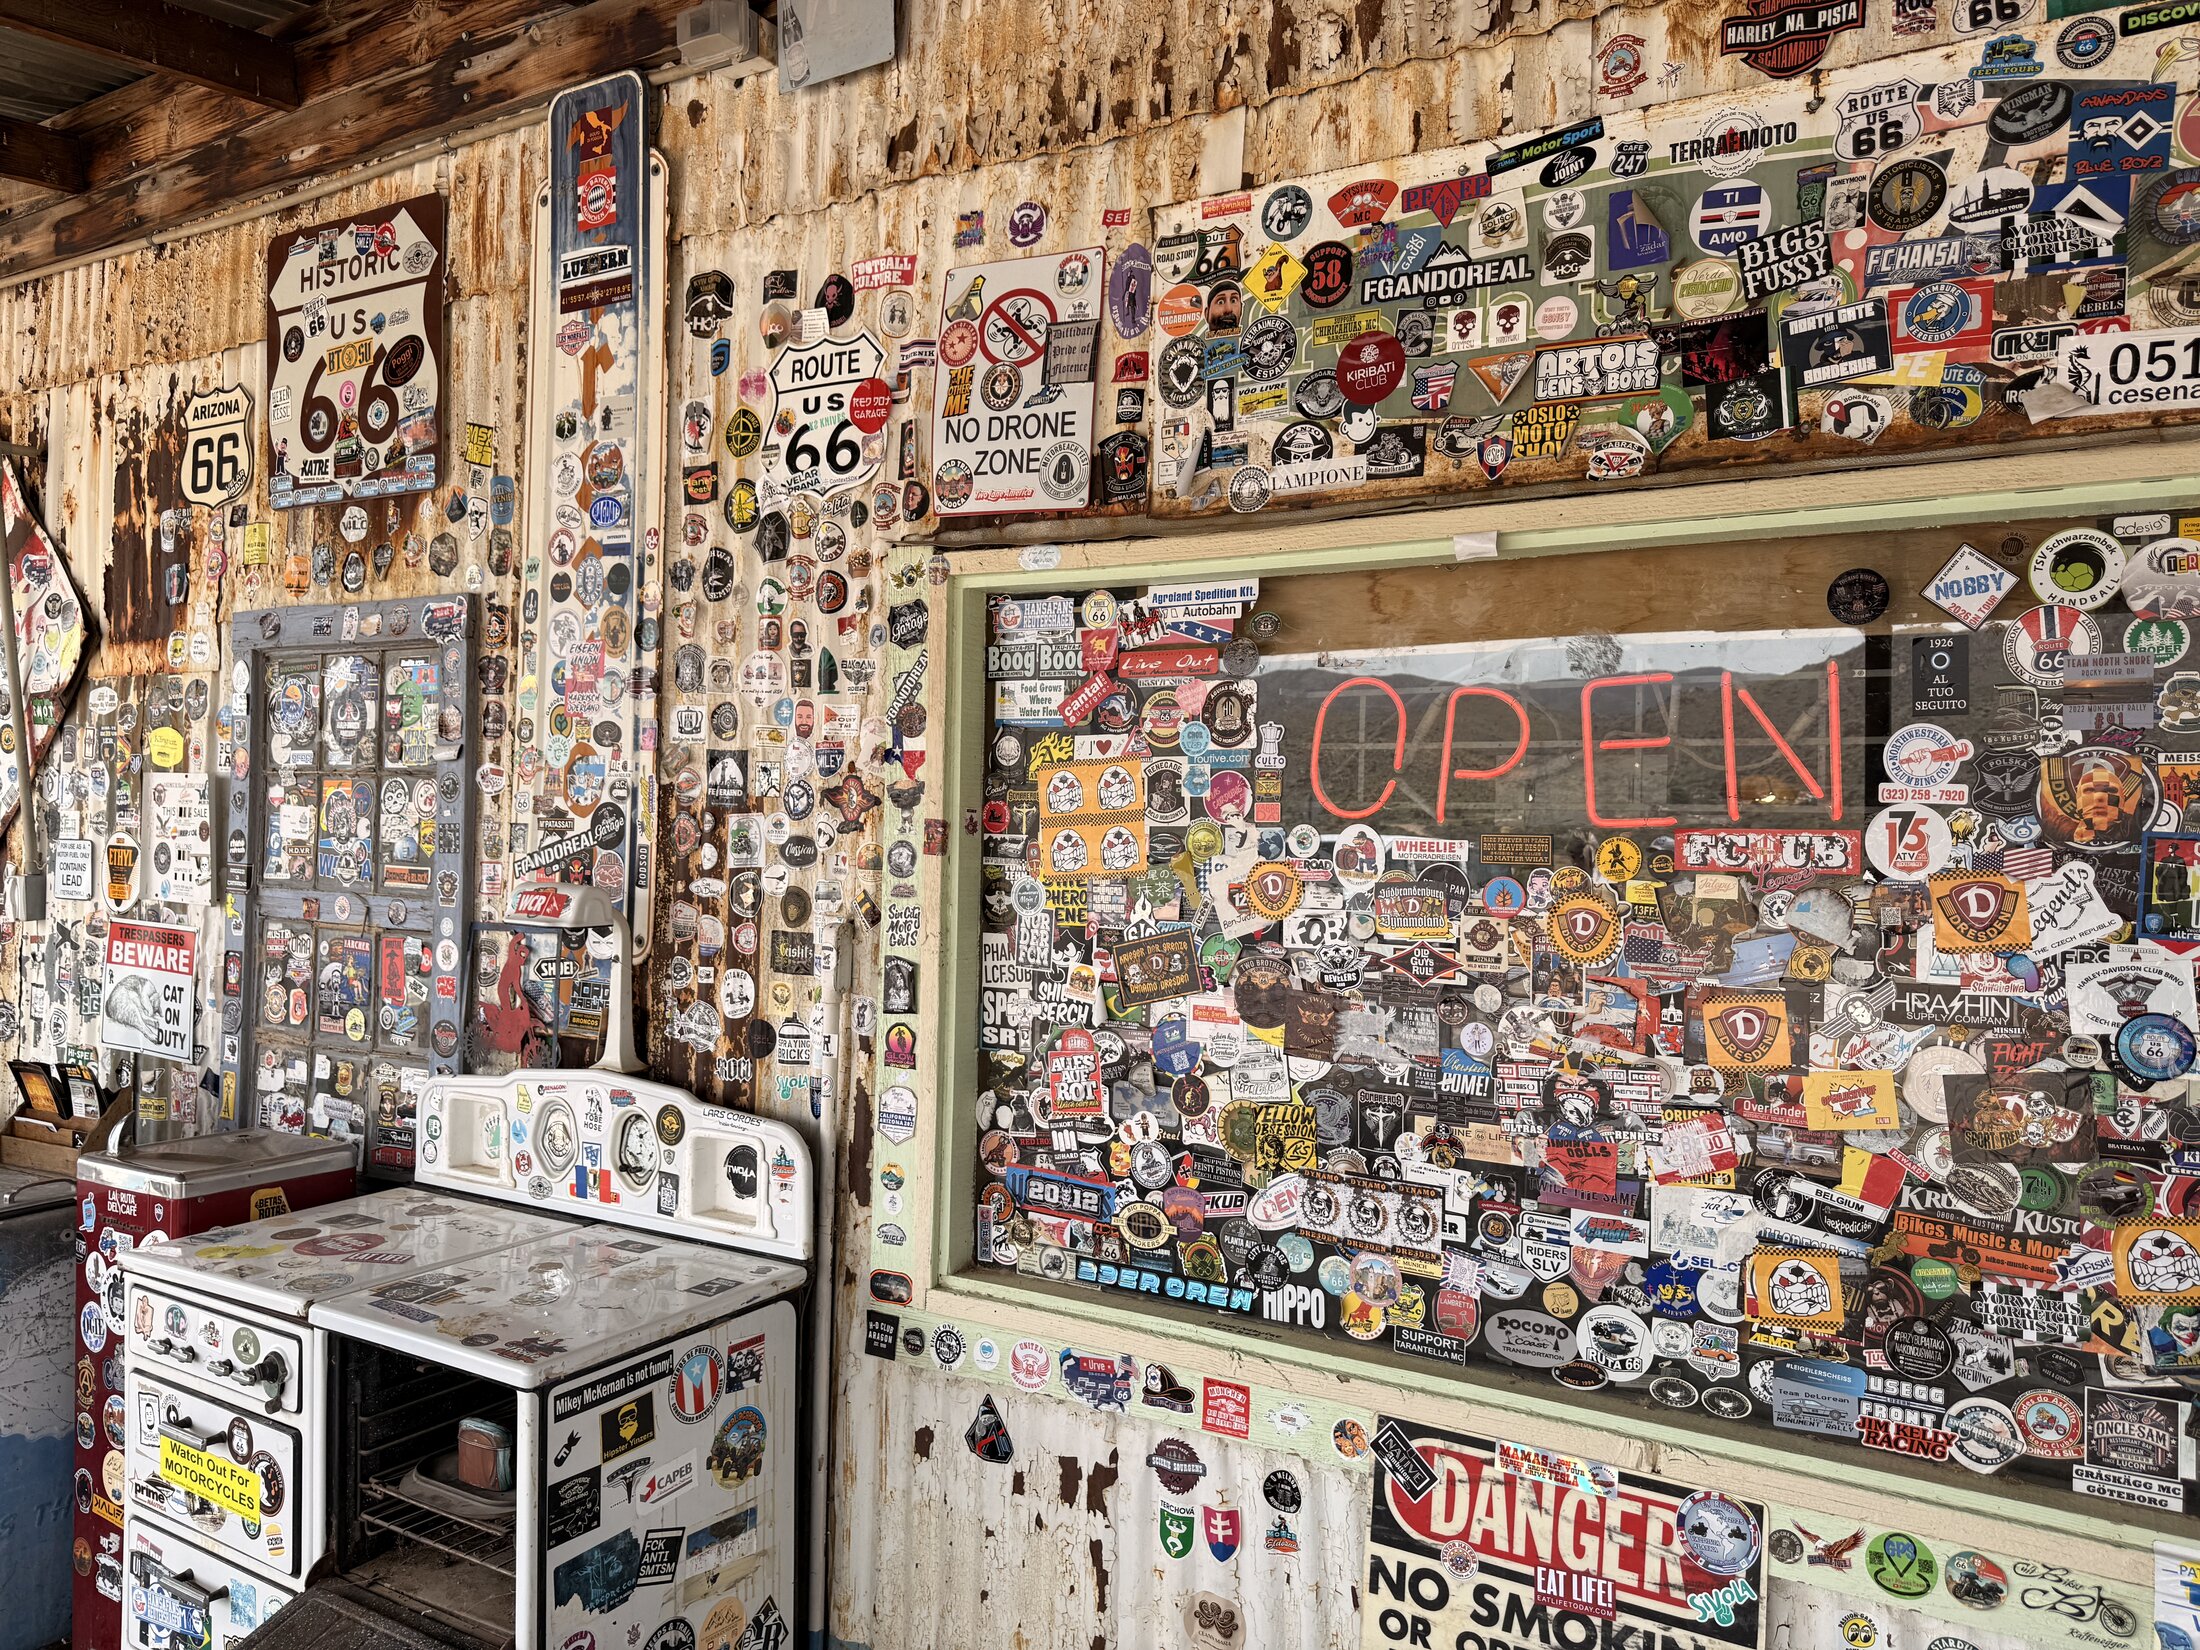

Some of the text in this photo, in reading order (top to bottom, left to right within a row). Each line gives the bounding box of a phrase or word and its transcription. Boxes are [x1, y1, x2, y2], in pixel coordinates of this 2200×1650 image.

[2077, 41, 2094, 52] 66
[1972, 63, 2041, 77] JEEP TOURS
[1848, 85, 1908, 113] ROUTE
[2001, 83, 2053, 112] WINGMAN
[1522, 122, 1602, 159] MotorSport
[1622, 143, 1644, 152] CAFE
[1852, 119, 1905, 158] 66
[1615, 153, 1642, 175] 247
[1830, 174, 1867, 187] HONEYMOON
[1723, 192, 1740, 205] TI
[1354, 211, 1371, 223] MC
[355, 235, 373, 249] SMILEY
[1709, 229, 1748, 245] AMO
[1310, 248, 1347, 262] SUPPORT
[301, 245, 400, 293] HISTORIC
[853, 256, 912, 278] FOOTBALL
[1311, 260, 1341, 291] 58
[1744, 248, 1828, 300] FUSSY
[1363, 256, 1534, 303] FGANDOREAL
[1917, 282, 1962, 298] HAMBURG
[2078, 299, 2124, 314] REBELS
[331, 309, 366, 339] US
[1788, 301, 1875, 335] NORTH GATE
[1908, 324, 1957, 343] BERGEDORF
[791, 349, 861, 383] ROUTE
[1537, 341, 1659, 378] ARTOIS
[1354, 375, 1388, 391] CLUB
[1964, 372, 1981, 384] 66
[300, 343, 399, 453] 66
[802, 393, 845, 414] US
[192, 399, 240, 421] ARIZONA
[1528, 404, 1566, 425] OSLO
[945, 410, 1077, 444] NO DRONE
[785, 418, 861, 476] 66
[1601, 441, 1639, 451] CABRAS
[191, 433, 239, 494] 66
[974, 447, 1041, 476] ZONE
[787, 478, 821, 495] PRANA
[1116, 492, 1146, 504] MALAYSIA
[1151, 585, 1256, 604] Agroland Spedition Kft.
[1934, 571, 2006, 601] NOBBY
[1091, 610, 1107, 622] 66
[1183, 603, 1237, 619] Autobahn
[1929, 637, 1954, 648] 1926
[988, 645, 1036, 670] Boog
[1020, 683, 1062, 693] Food Grows
[1927, 687, 1954, 697] TUO
[1915, 699, 1967, 710] SEGUITO
[2068, 703, 2147, 714] 2022 MONUMENT RALLY
[1310, 659, 1843, 829] OPEN
[1888, 727, 1951, 762] NORTHWESTERN
[1256, 755, 1286, 766] CULTO
[1988, 759, 2028, 769] POLSKA
[594, 816, 626, 839] Garage
[1395, 840, 1457, 854] WHEELIE
[1397, 852, 1462, 861] MOTORRADREISEN
[1895, 851, 1916, 862] ATV
[60, 861, 89, 872] CONTAINS
[62, 875, 82, 887] LEAD
[1135, 882, 1171, 898] 抹茶
[518, 892, 543, 912] WCR
[1255, 890, 1291, 912] DRESDEN
[118, 926, 184, 947] TRESPASSERS
[1949, 913, 2012, 944] DRESDEN
[111, 941, 191, 973] BEWARE
[1410, 956, 1434, 967] GUYS
[1413, 948, 1429, 959] OLD
[1324, 973, 1357, 984] REVELERS
[1412, 966, 1434, 977] RULE
[163, 984, 184, 1004] CAT
[165, 1008, 180, 1027] ON
[1906, 1011, 2008, 1026] SUPPLY COMPANY
[157, 1028, 186, 1051] DUTY
[1721, 1033, 1775, 1063] DRESDEN
[2146, 1047, 2164, 1058] 66
[1051, 1054, 1095, 1073] ALLES
[1061, 1071, 1089, 1084] AUF
[1056, 1083, 1097, 1102] ROT
[1743, 1100, 1806, 1119] Overlander
[1614, 1130, 1660, 1142] RENNES
[2107, 1142, 2145, 1152] BRATISLAVA
[1193, 1160, 1242, 1178] FEISTY PISTONS
[1201, 1156, 1230, 1167] SUPPORT
[1891, 1151, 1927, 1179] REWARDS
[1350, 1178, 1387, 1193] DYNAMO
[259, 1195, 282, 1207] BETAS
[1814, 1188, 1865, 1213] BELGIUM
[258, 1203, 286, 1218] ROTAS
[883, 1233, 904, 1242] NIGLO
[1526, 1246, 1567, 1261] RIDERS
[1531, 1256, 1561, 1273] SLV
[1262, 1288, 1325, 1329] HIPPO
[1977, 1290, 2082, 1315] VORWÄRTS
[1496, 1317, 1569, 1341] POCONO
[1982, 1313, 2078, 1337] BORUSSIA
[1018, 1341, 1043, 1355] UNITED
[1401, 1329, 1459, 1350] SUPPORT
[1087, 1359, 1106, 1372] Urve
[1785, 1363, 1852, 1384] #LEIGEILERSCHEISS
[1954, 1366, 1994, 1385] BREWING
[554, 1355, 673, 1416] Mikey McKernan is not funny!
[1116, 1390, 1128, 1400] 66
[1778, 1388, 1850, 1405] Team DeLorean
[1777, 1416, 1855, 1433] MONUMENT RALLY
[1858, 1424, 1956, 1447] JIM KELLY
[1499, 1443, 1549, 1467] MAMAS
[1866, 1434, 1947, 1460] RACING
[2117, 1445, 2144, 1456] AMERICAN
[170, 1440, 250, 1489] Watch Out For
[1152, 1456, 1203, 1475] SCIERIE SOURGENS
[1385, 1437, 1425, 1484] NATIVE
[164, 1459, 256, 1511] MOTORCYCLES
[656, 1461, 693, 1490] CAPEB
[2074, 1466, 2182, 1496] GRÅSKÄGG MC
[134, 1481, 166, 1505] prime
[2086, 1484, 2169, 1508] GÖTEBORG
[1160, 1498, 1195, 1516] TERCHOVÁ
[1430, 1451, 1690, 1605] DANGER
[645, 1539, 665, 1552] FCK
[642, 1551, 669, 1564] ANTI
[639, 1562, 675, 1577] SMTSM
[1368, 1554, 1450, 1612] NO
[1537, 1566, 1613, 1608] EAT LIFE!
